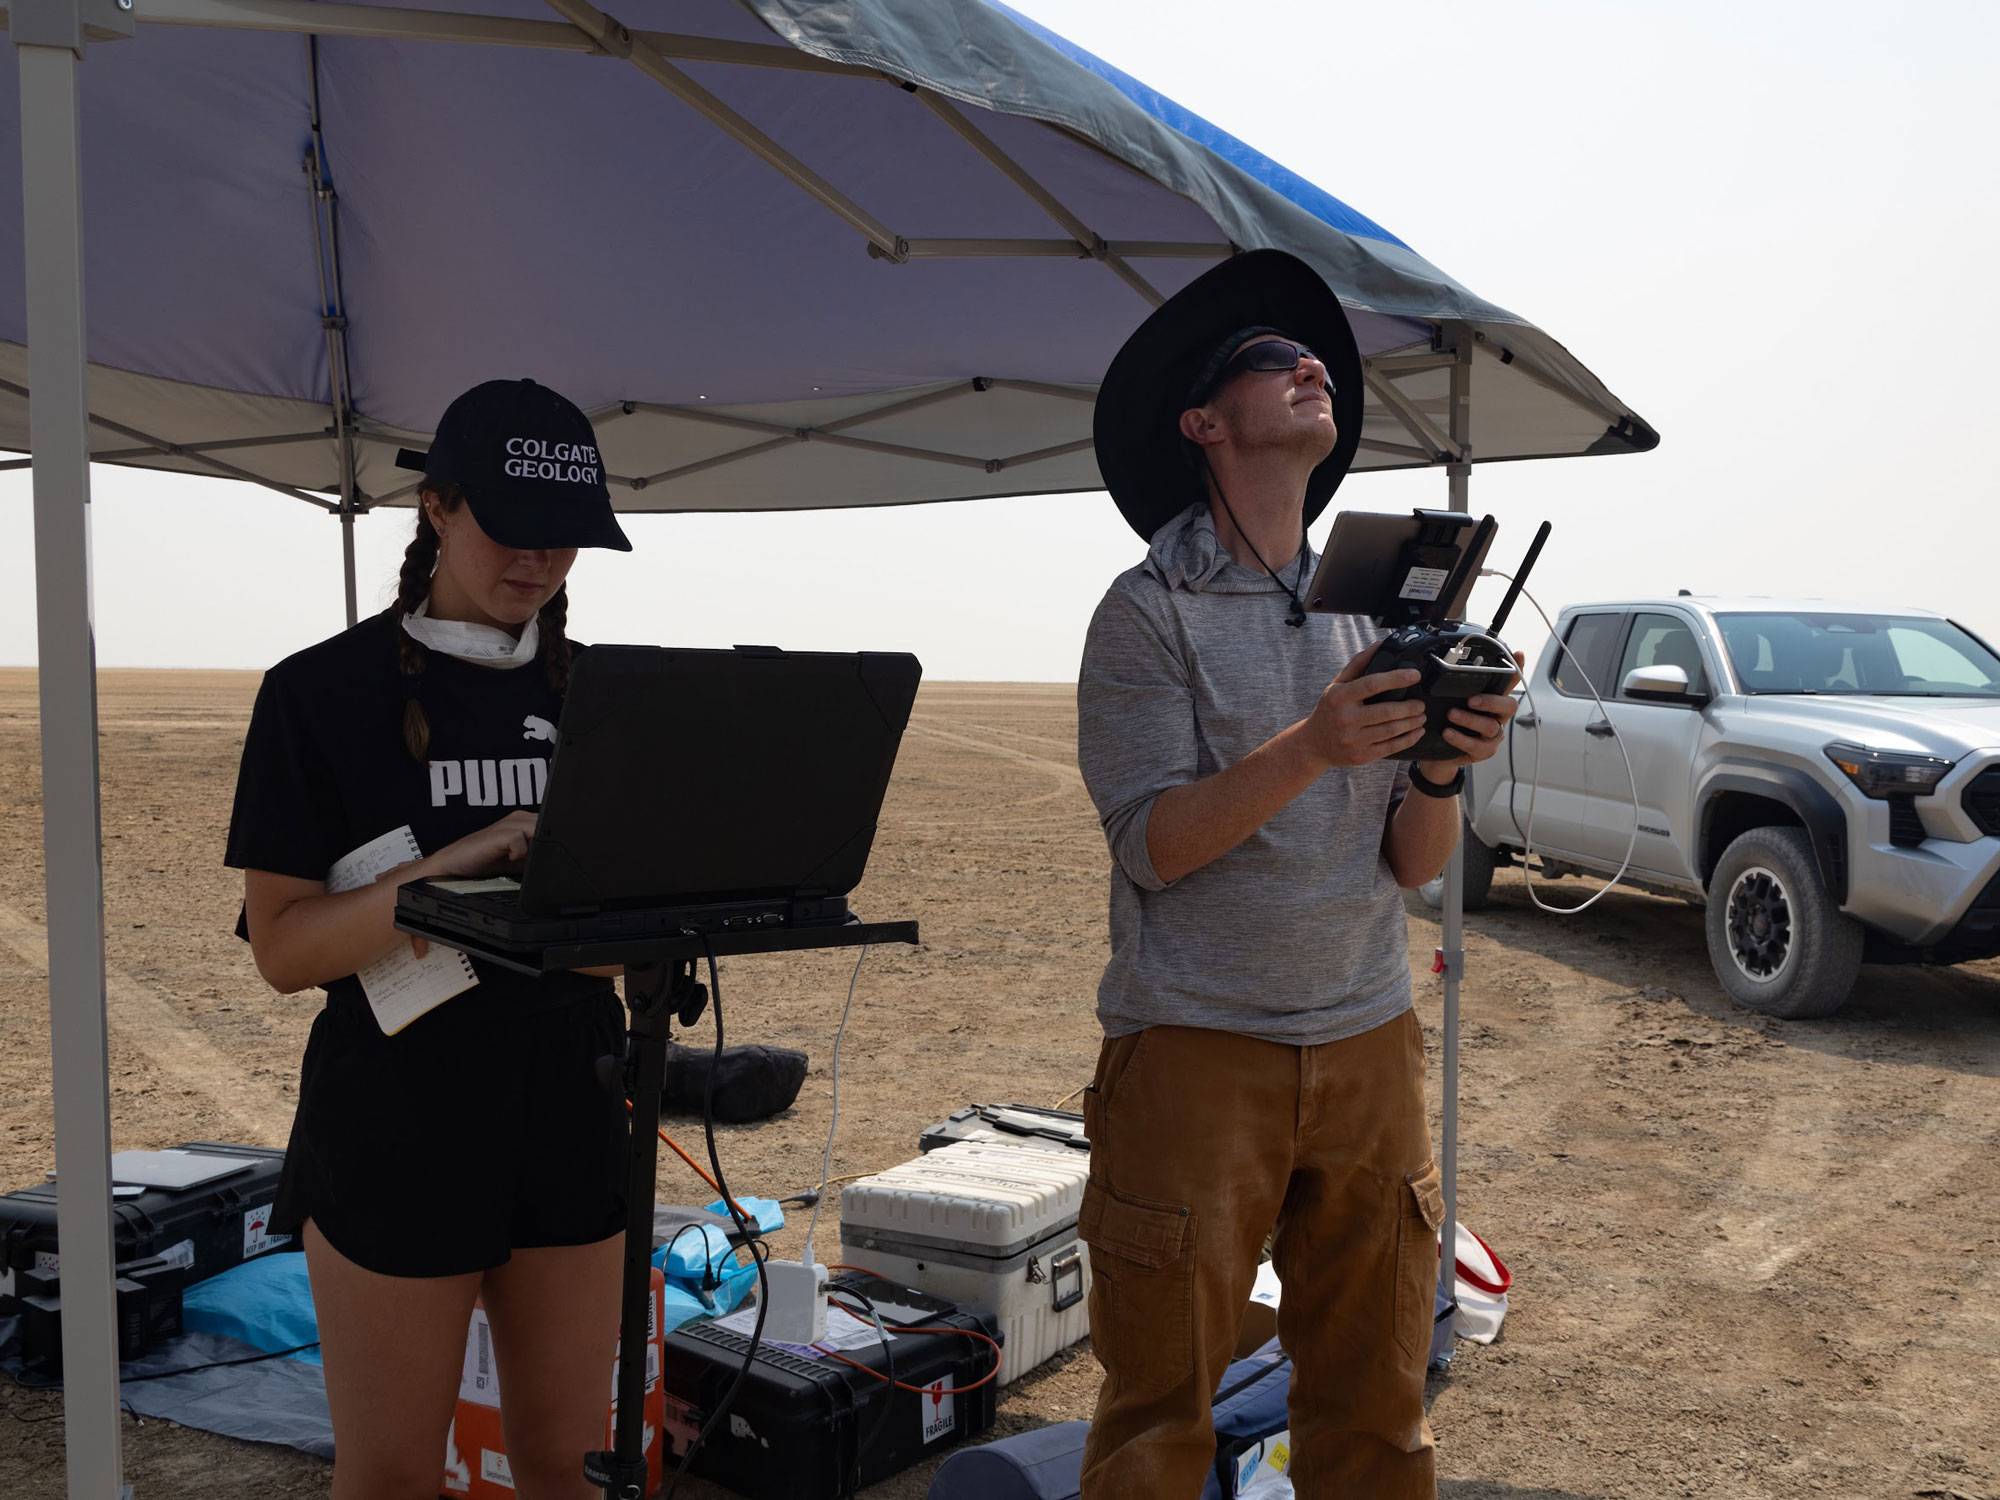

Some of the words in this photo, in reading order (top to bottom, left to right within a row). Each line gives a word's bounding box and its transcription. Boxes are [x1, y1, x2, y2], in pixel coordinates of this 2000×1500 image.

[506, 437, 597, 464] COLGATE
[504, 459, 598, 485] GEOLOGY
[429, 758, 551, 806] PUM
[926, 1415, 953, 1438] FRAGILE
